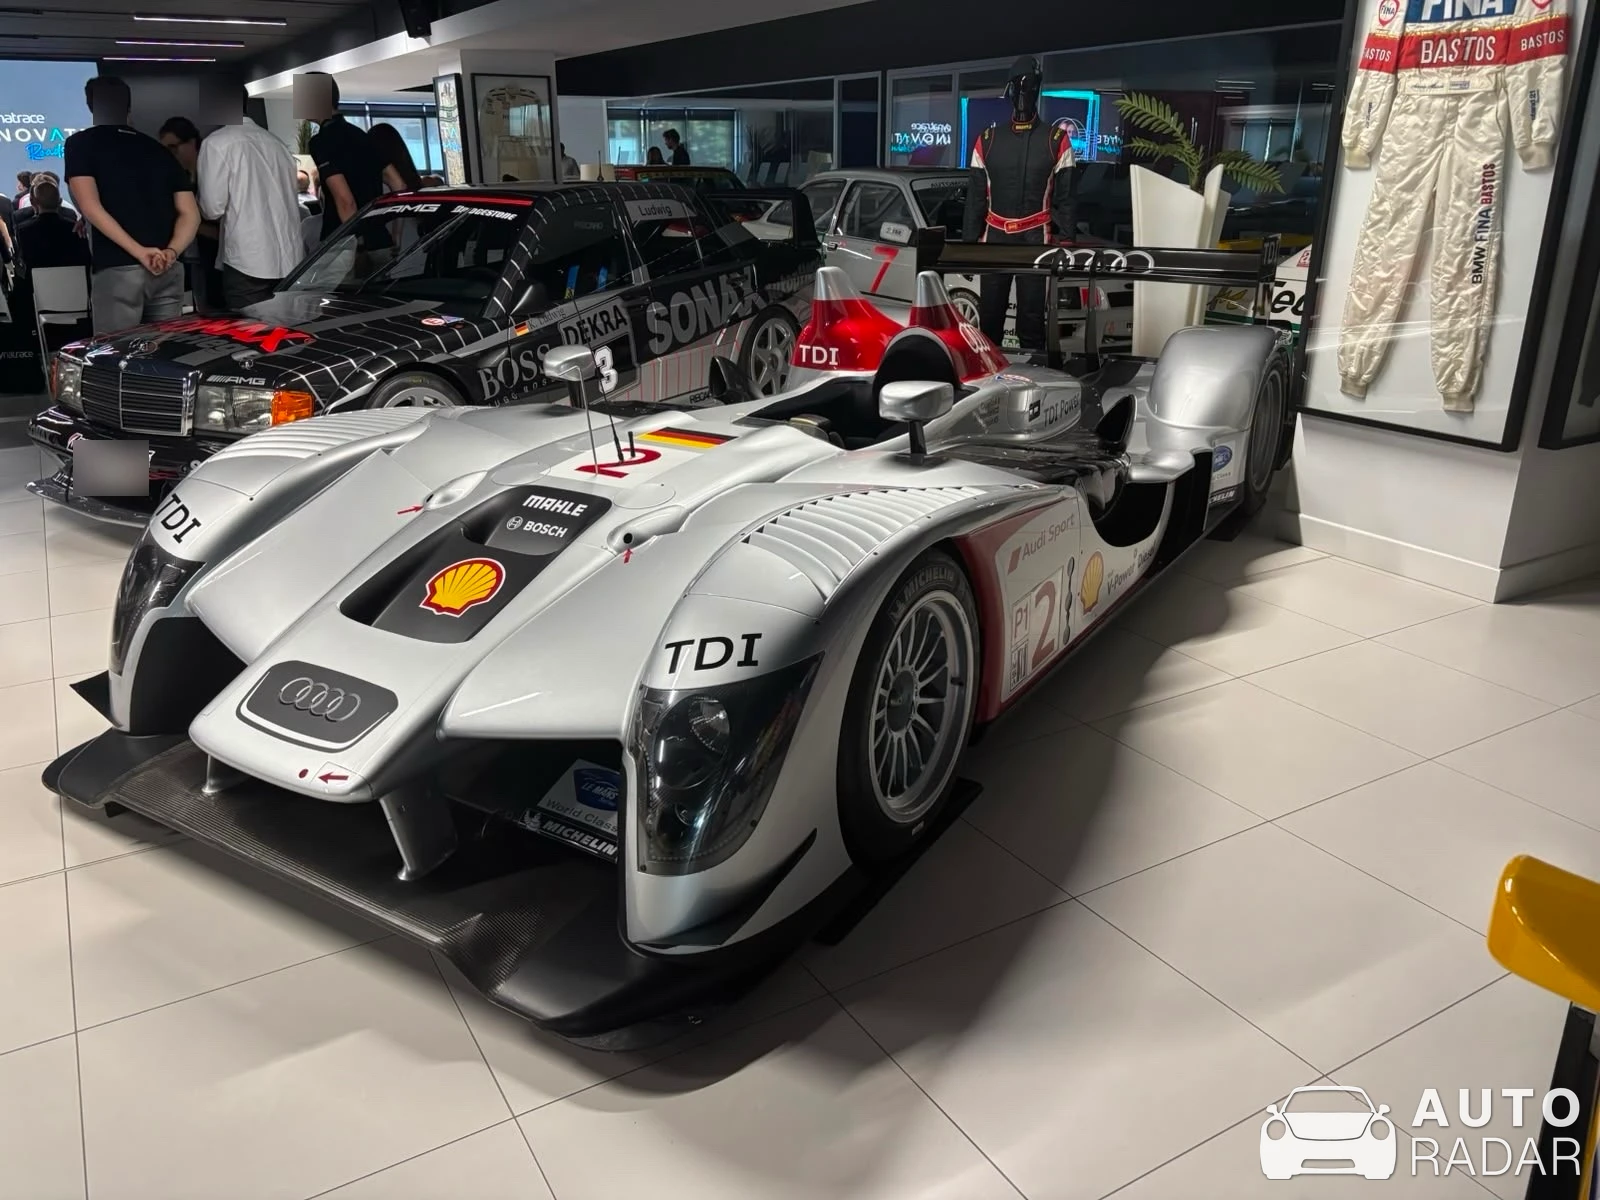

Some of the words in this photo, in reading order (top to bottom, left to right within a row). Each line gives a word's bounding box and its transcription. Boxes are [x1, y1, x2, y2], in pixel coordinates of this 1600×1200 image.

[1364, 47, 1392, 62] ASTOS
[1421, 36, 1496, 64] BASTOS
[1520, 29, 1565, 51] BASTOS
[25, 142, 64, 161] Road
[1480, 162, 1496, 206] BASTOS
[638, 204, 673, 217] Ludwig
[1474, 207, 1492, 243] FINA
[870, 246, 899, 295] 7
[1471, 246, 1487, 285] BMW
[537, 306, 567, 326] Ludwig
[563, 304, 628, 345] DEKRA
[646, 264, 767, 354] SONAX
[593, 345, 619, 394] 3
[799, 344, 839, 366] TDI
[226, 377, 267, 386] AMG
[1044, 406, 1059, 428] TDI
[1060, 393, 1080, 419] Power
[575, 448, 661, 479] 2
[156, 493, 201, 544] TDI
[523, 494, 588, 517] MAHLE
[523, 520, 568, 539] BOSCH
[1021, 529, 1046, 561] Audi
[1048, 513, 1075, 542] Sport
[903, 566, 954, 602] MICHELIN
[1014, 602, 1028, 639] P1
[1031, 580, 1056, 671] 2
[664, 633, 763, 674] TDI
[546, 798, 584, 817] World
[591, 784, 618, 800] MANS
[543, 820, 618, 856] MICHELIN
